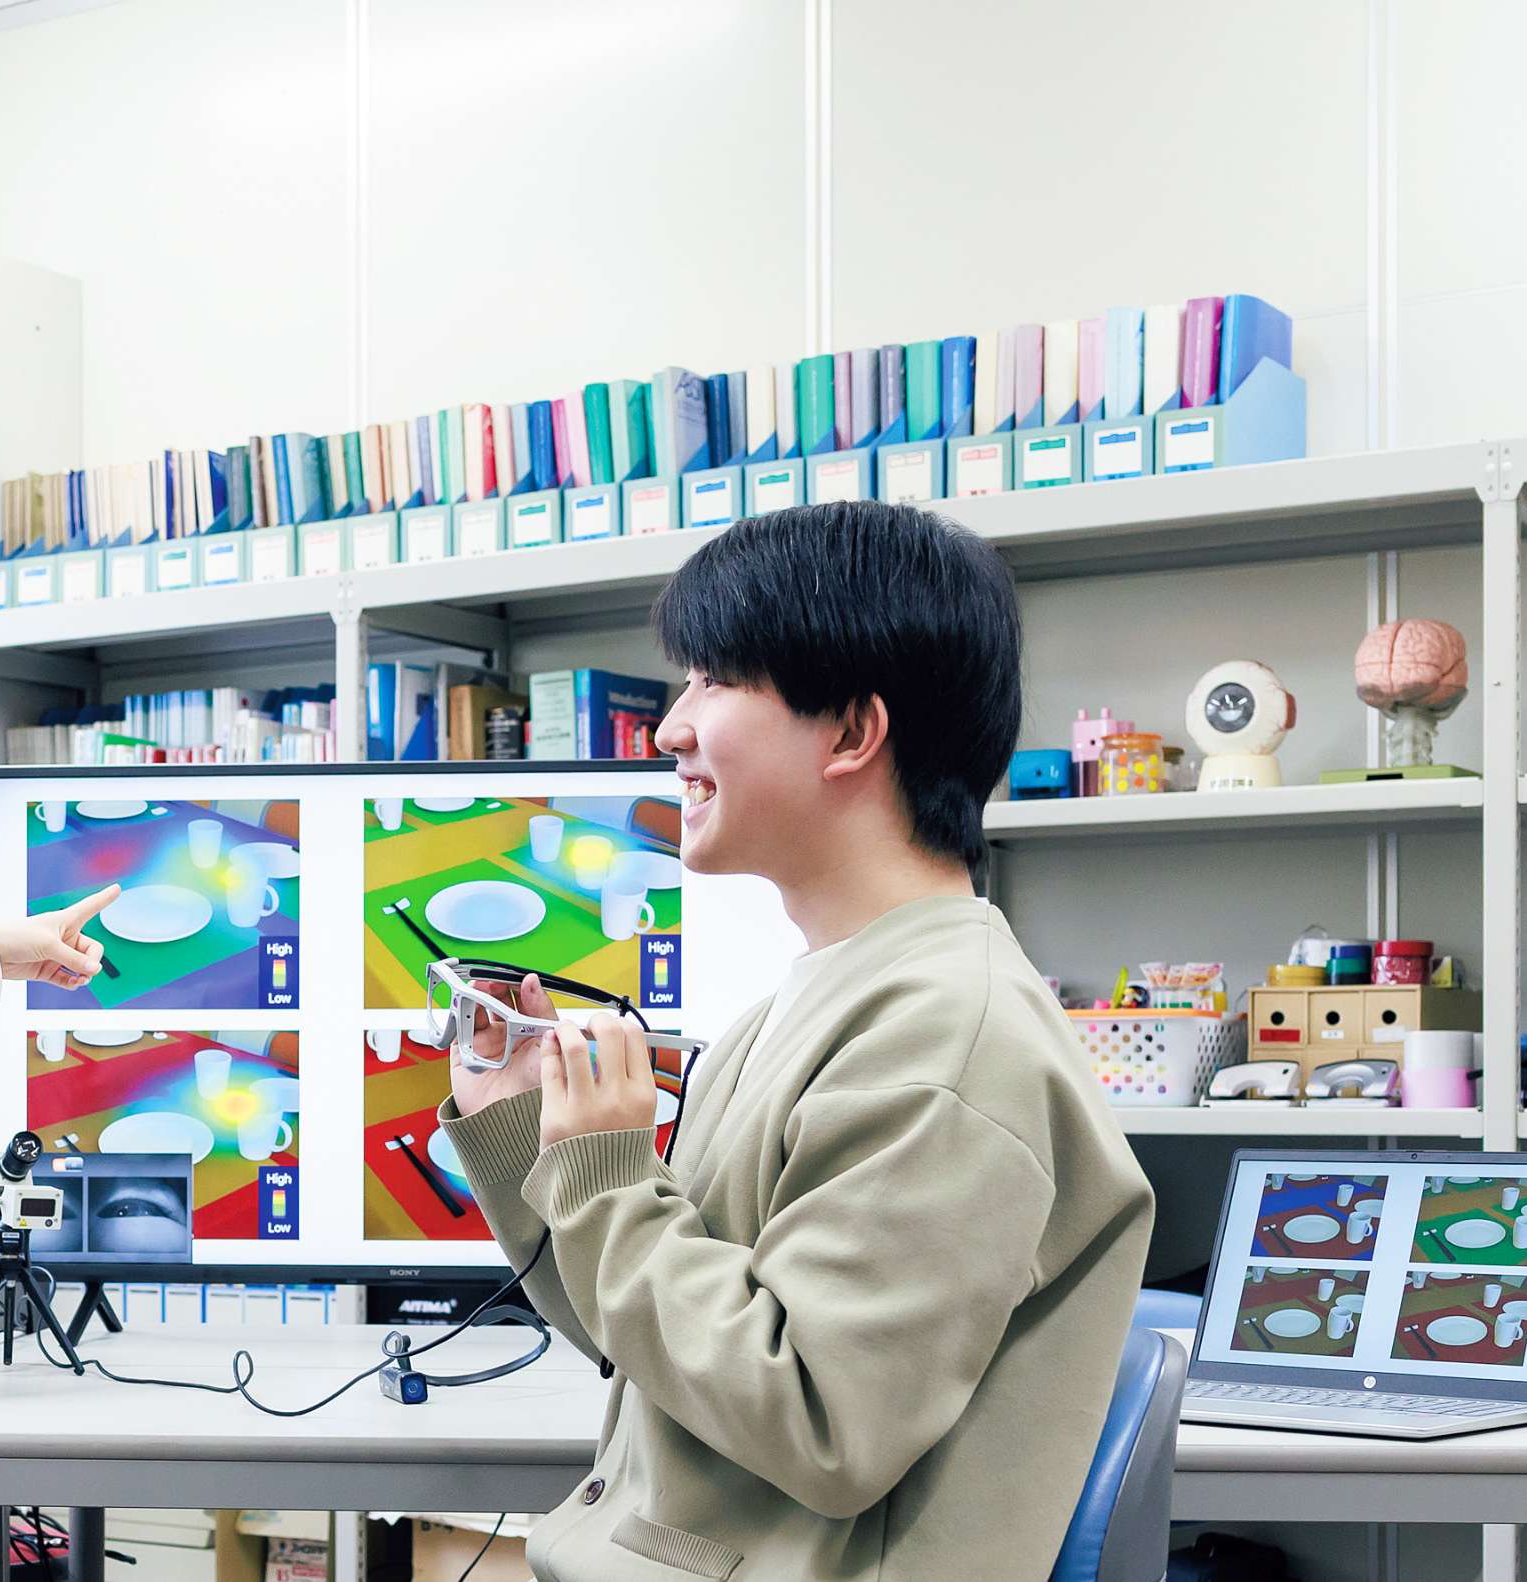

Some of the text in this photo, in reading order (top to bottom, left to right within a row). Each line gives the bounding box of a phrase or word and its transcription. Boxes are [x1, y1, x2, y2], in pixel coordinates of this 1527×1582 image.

[267, 943, 293, 957] High
[648, 941, 674, 955] High
[268, 992, 292, 1004] Low
[649, 991, 673, 1003] Low
[266, 1172, 292, 1186] High
[268, 1222, 292, 1233] Low
